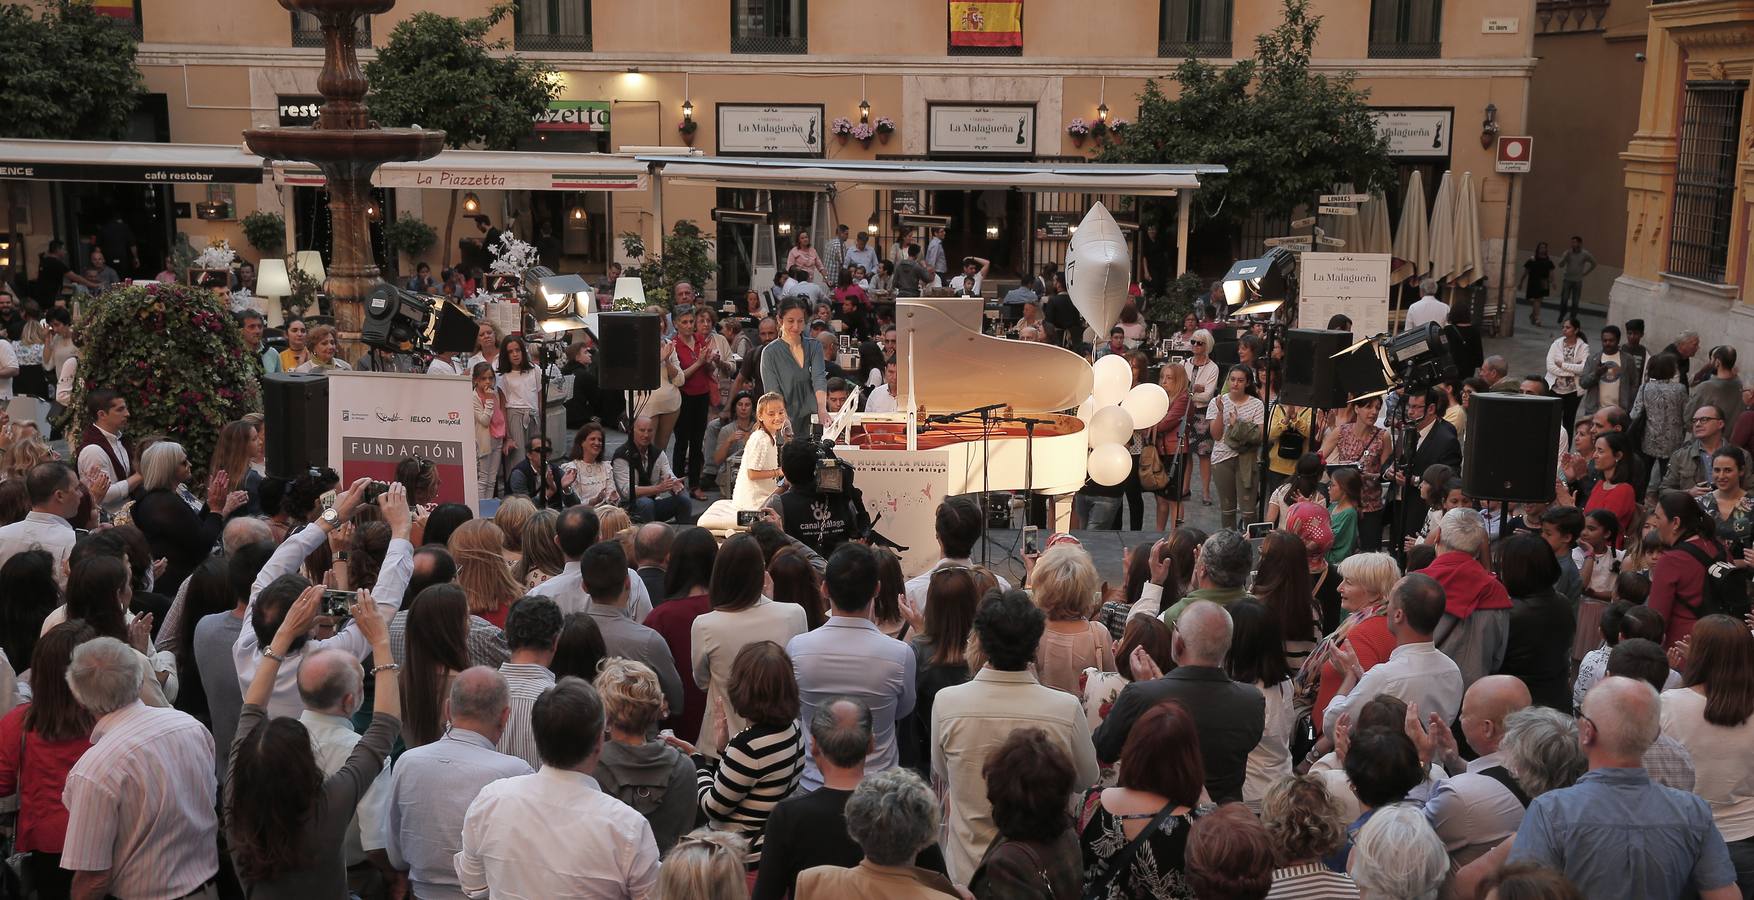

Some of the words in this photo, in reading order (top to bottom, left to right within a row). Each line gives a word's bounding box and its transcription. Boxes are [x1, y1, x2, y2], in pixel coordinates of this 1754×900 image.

[280, 104, 320, 117] rest
[738, 123, 749, 132] La
[752, 123, 803, 133] Malagueña
[950, 123, 960, 132] La
[963, 123, 1013, 133] Malagueña
[144, 171, 167, 180] café
[170, 172, 213, 181] restobar
[417, 173, 432, 185] La
[440, 172, 505, 186] Piazzetta
[1313, 273, 1324, 281] La
[1327, 273, 1377, 283] Malagueña
[352, 442, 455, 458] FUNDACIÓN
[800, 521, 820, 530] canal
